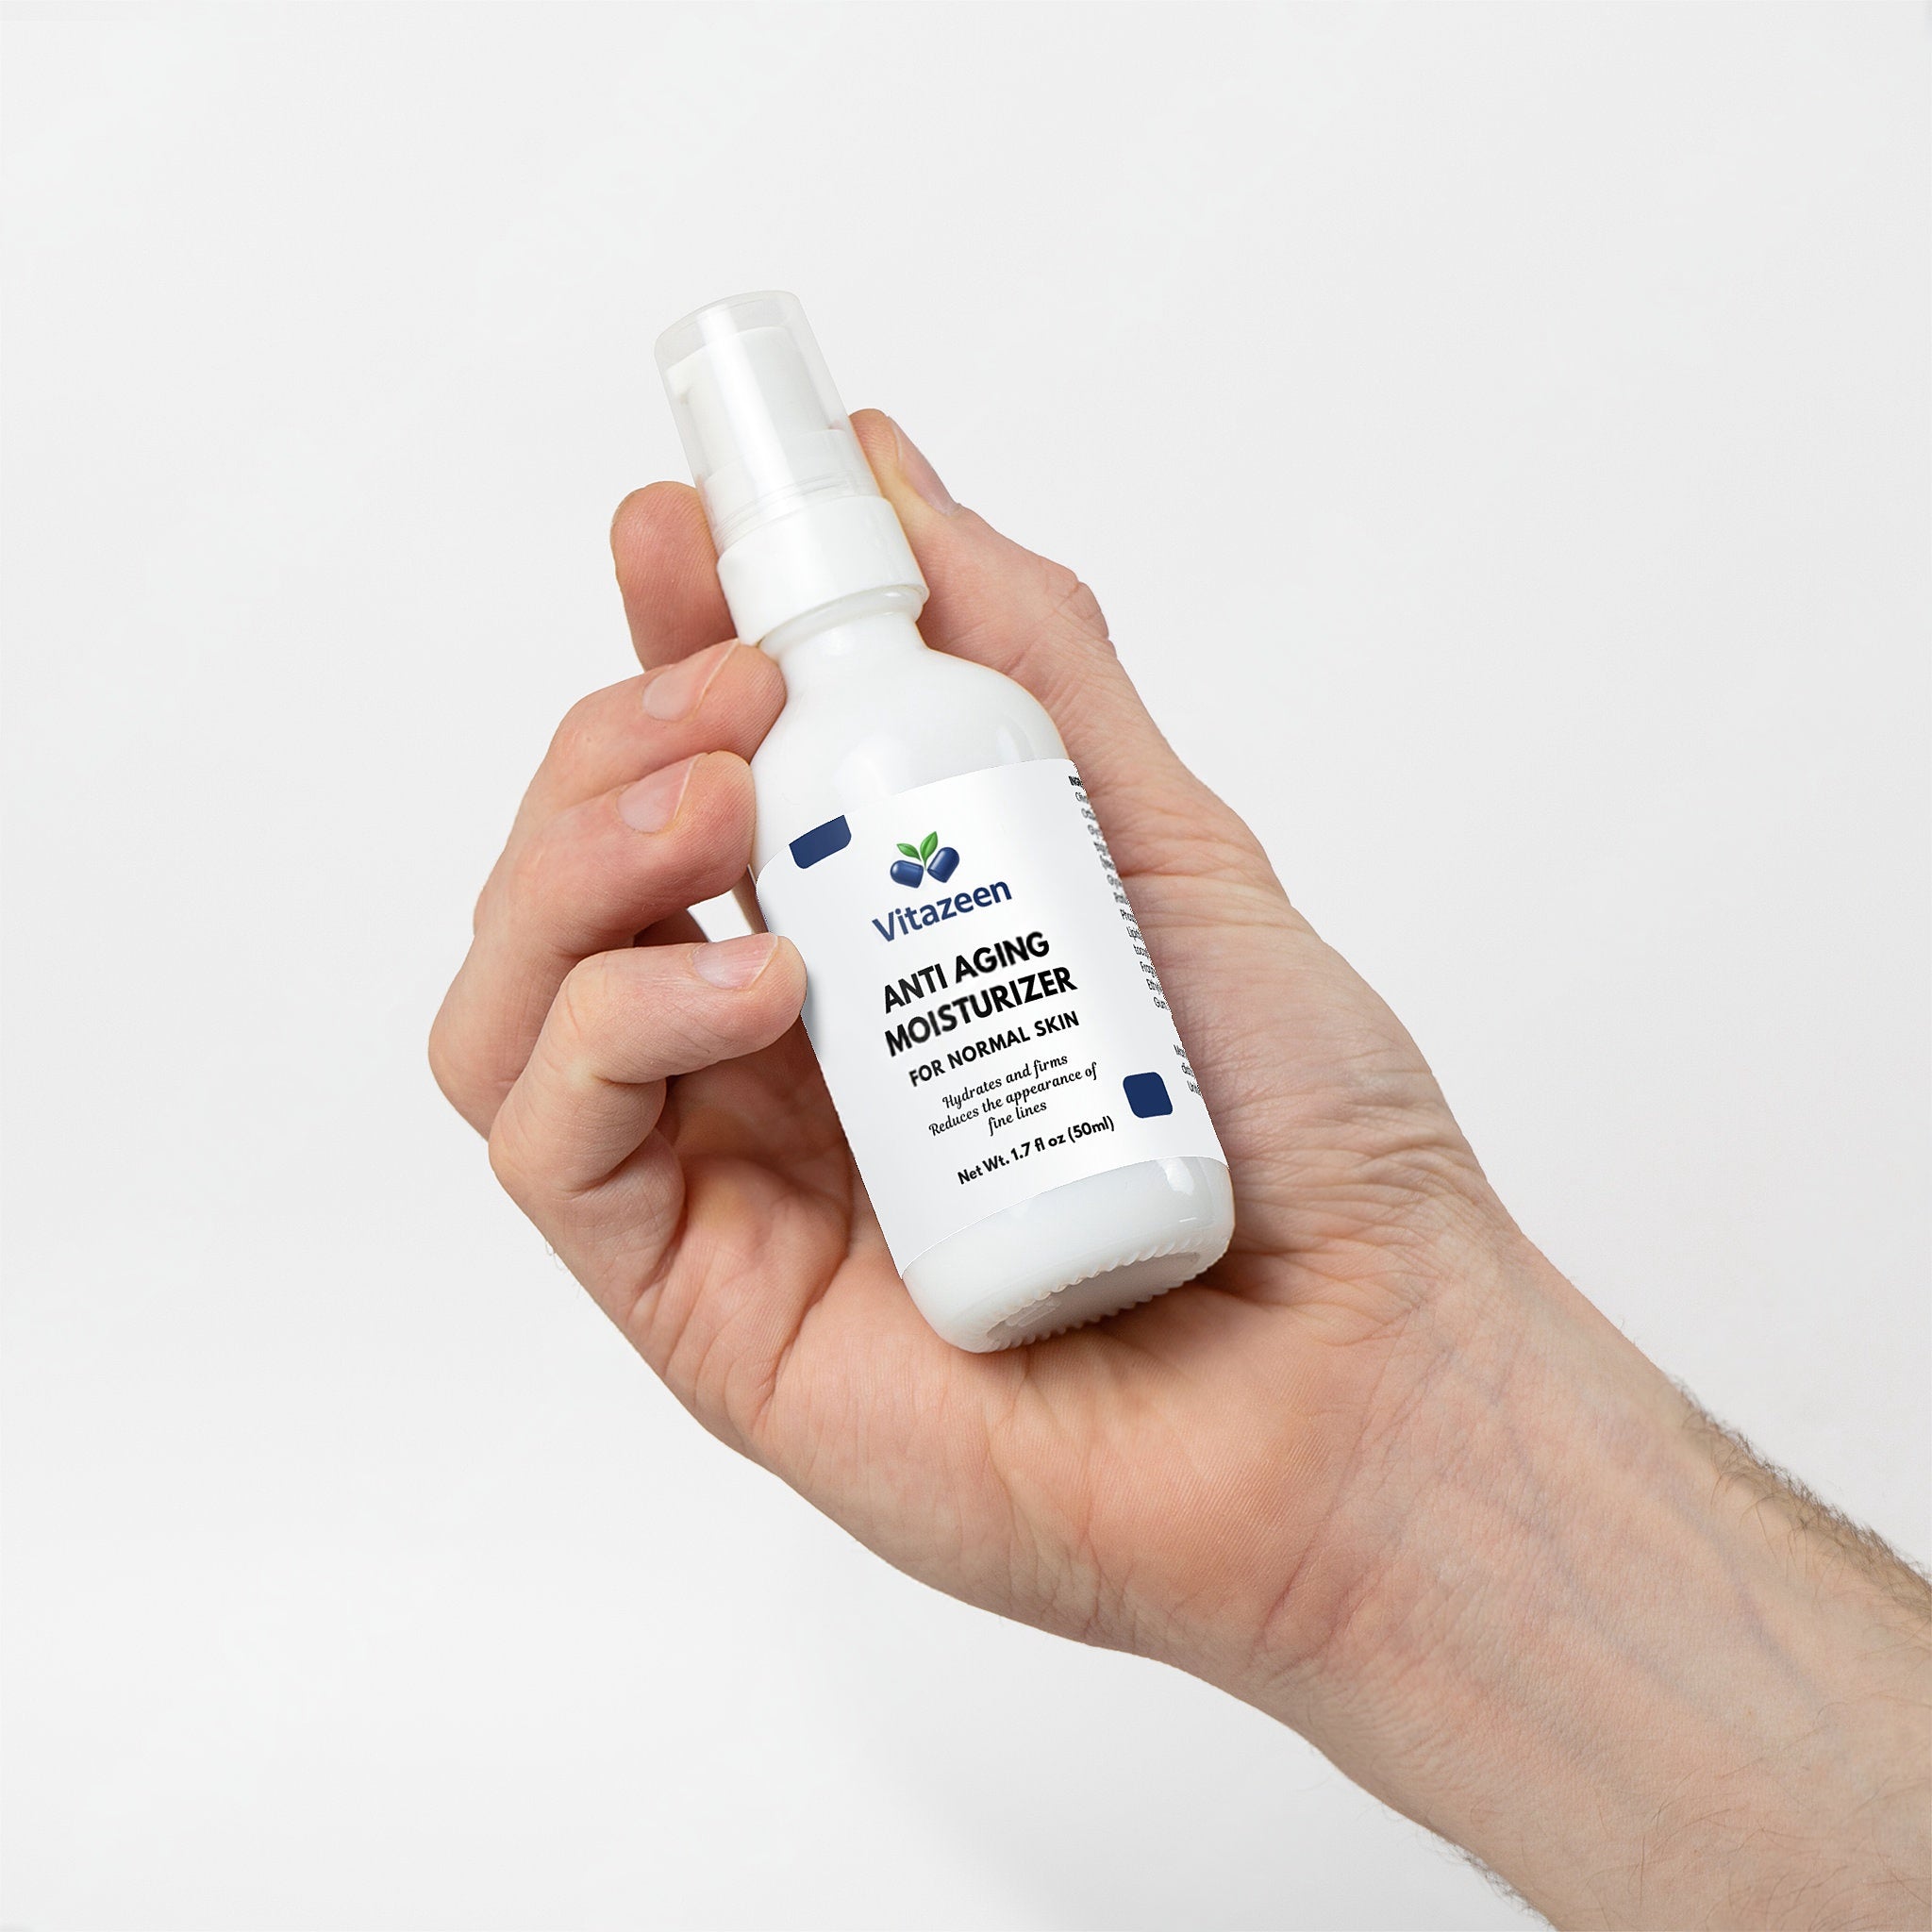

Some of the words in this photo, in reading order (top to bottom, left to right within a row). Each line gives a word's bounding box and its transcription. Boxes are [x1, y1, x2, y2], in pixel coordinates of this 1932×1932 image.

[872, 881, 1012, 942] Vitazeen
[884, 963, 949, 1014] ANTI
[955, 931, 1050, 984] AGING
[884, 966, 1078, 1058] MOISTURIZER
[908, 1059, 946, 1088] FOR
[946, 1025, 1031, 1070] NORMAL
[1034, 1010, 1080, 1038] SKIN
[941, 1078, 1003, 1110] Hydrates
[1006, 1062, 1032, 1084] and
[1033, 1055, 1068, 1080] firms
[928, 1108, 980, 1137] Reduces
[981, 1097, 1004, 1114] the
[1006, 1071, 1083, 1107] appearance
[1084, 1061, 1098, 1081] of
[988, 1114, 1014, 1137] fine
[1014, 1101, 1047, 1121] lines
[957, 1165, 984, 1185] Net
[981, 1154, 1010, 1173] Wt.
[1010, 1141, 1031, 1161] 1.7
[1034, 1137, 1046, 1153] fl
[1047, 1134, 1067, 1147] oz
[1067, 1115, 1115, 1143] (50ml)
